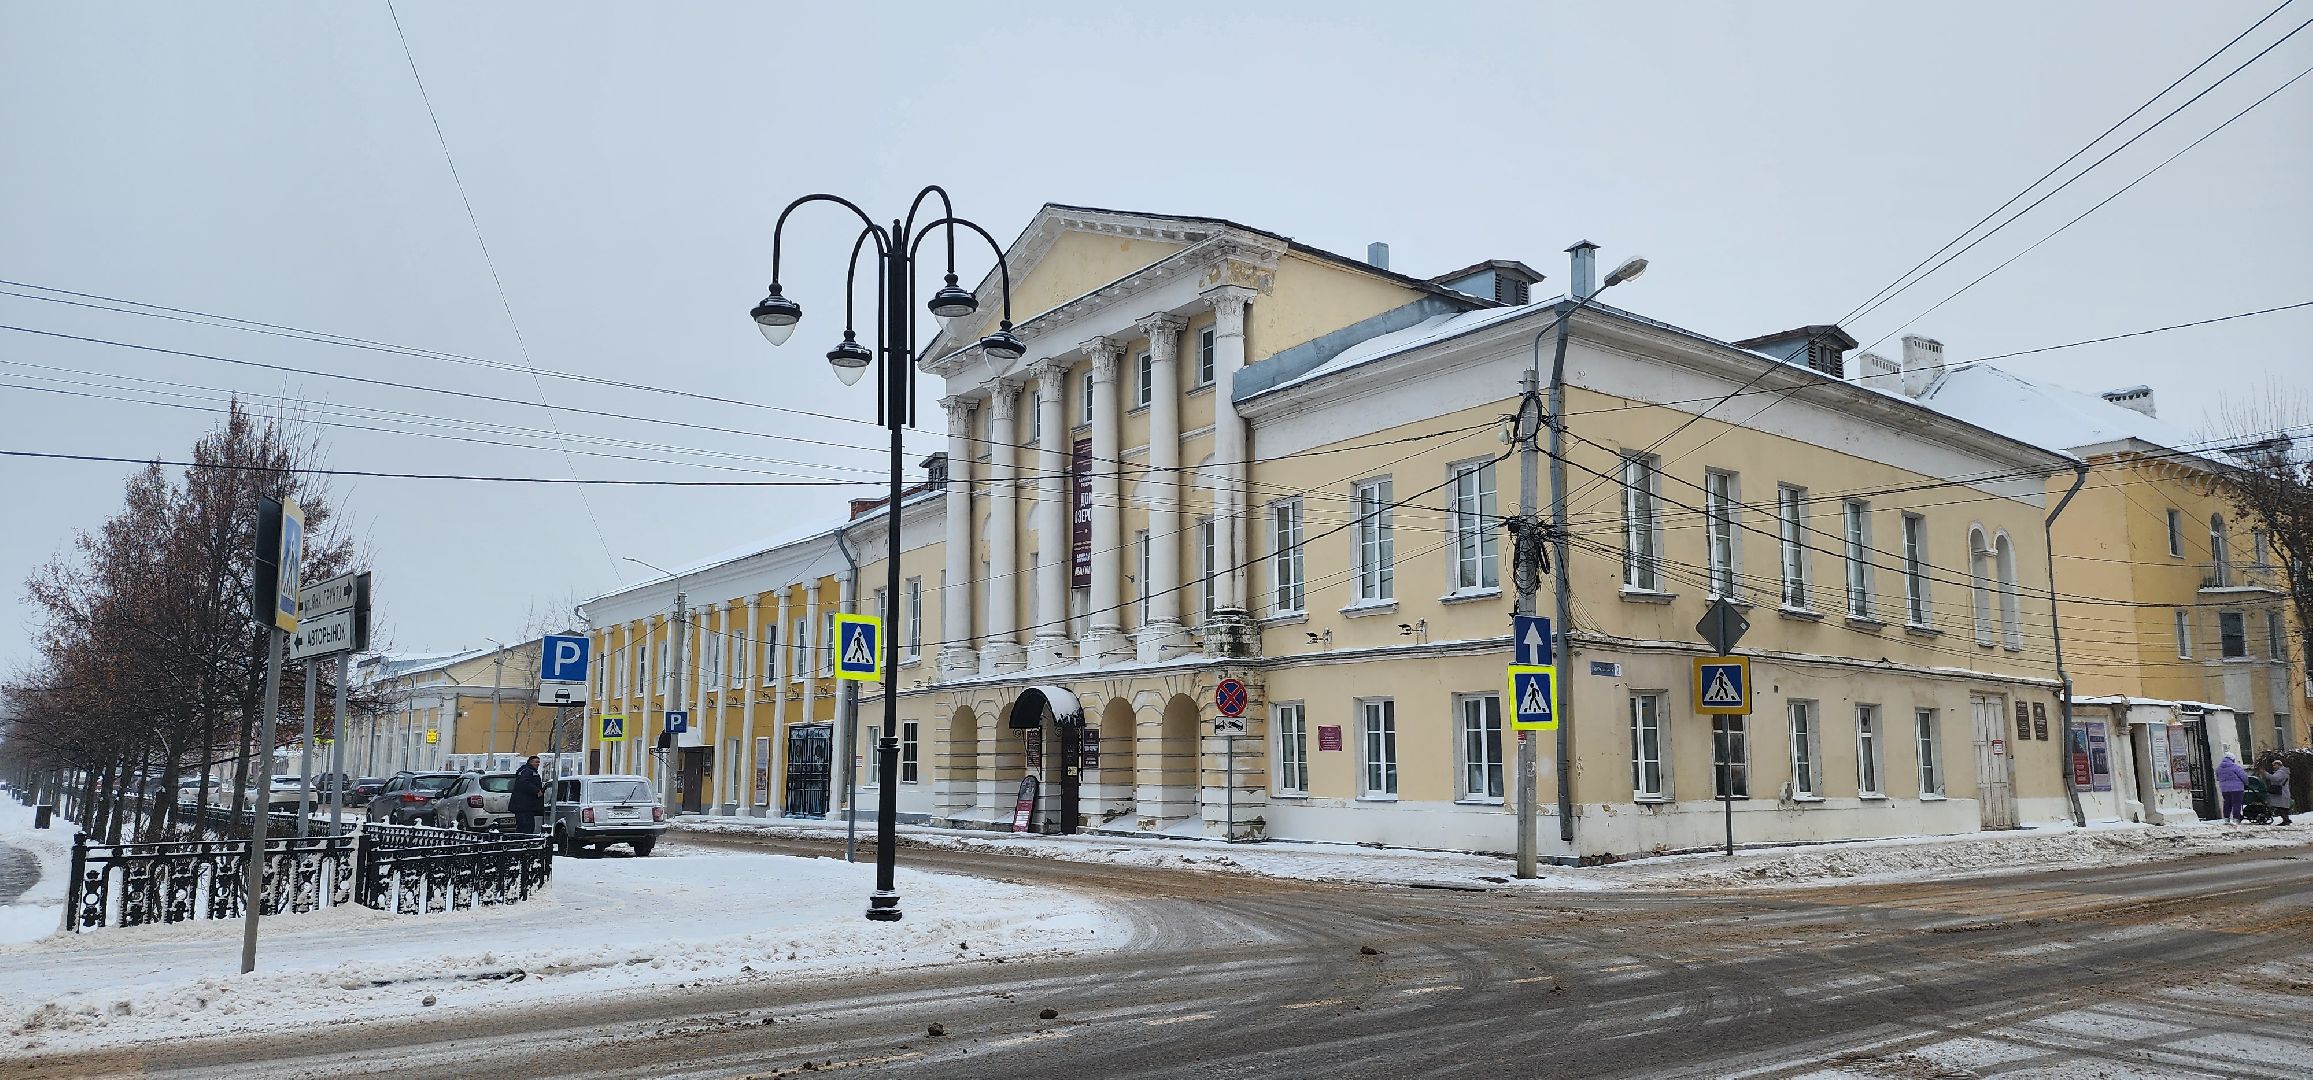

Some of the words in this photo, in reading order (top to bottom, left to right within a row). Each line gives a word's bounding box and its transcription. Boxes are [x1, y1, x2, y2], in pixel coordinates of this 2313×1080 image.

[307, 622, 346, 648] АВТОРЫНОК
[554, 641, 581, 676] P
[670, 714, 682, 731] P
